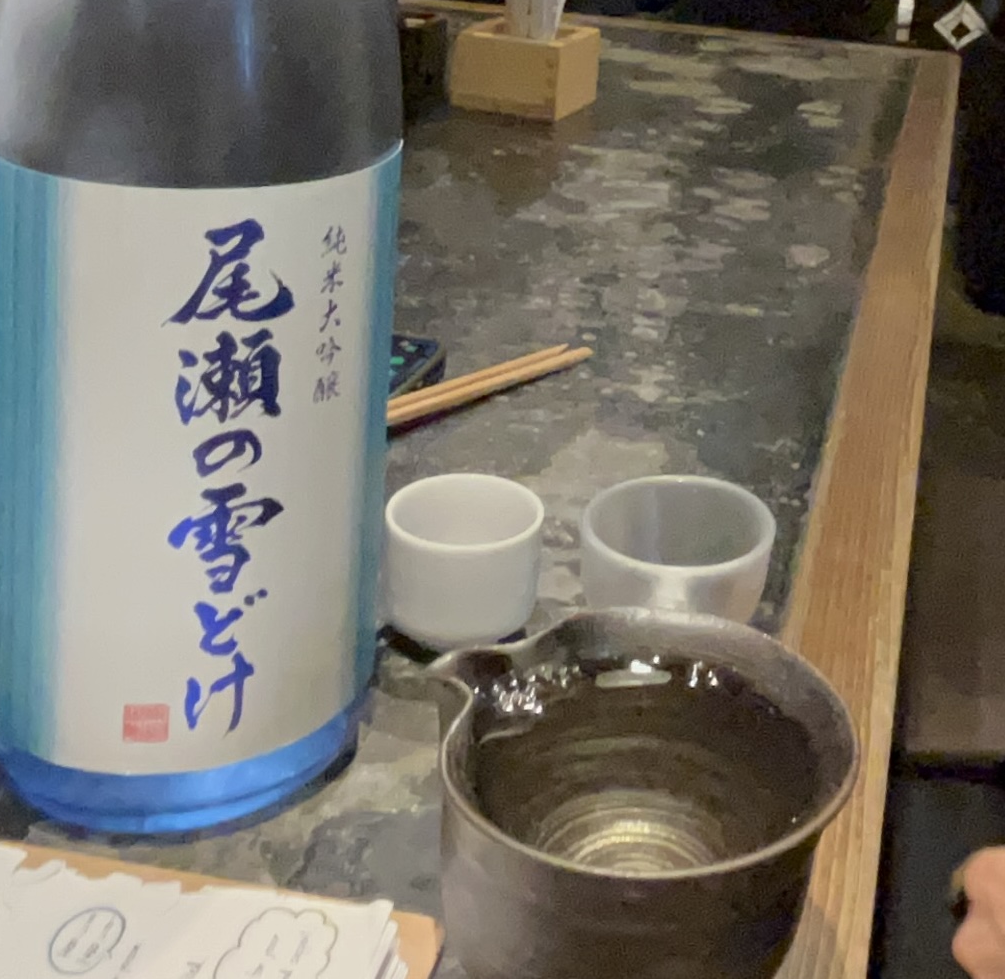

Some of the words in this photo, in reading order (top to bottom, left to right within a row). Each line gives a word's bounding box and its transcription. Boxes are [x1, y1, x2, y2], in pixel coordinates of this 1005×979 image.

[161, 218, 295, 740] 尾瀬の雪どけ
[312, 225, 348, 402] 純米大吟醸
